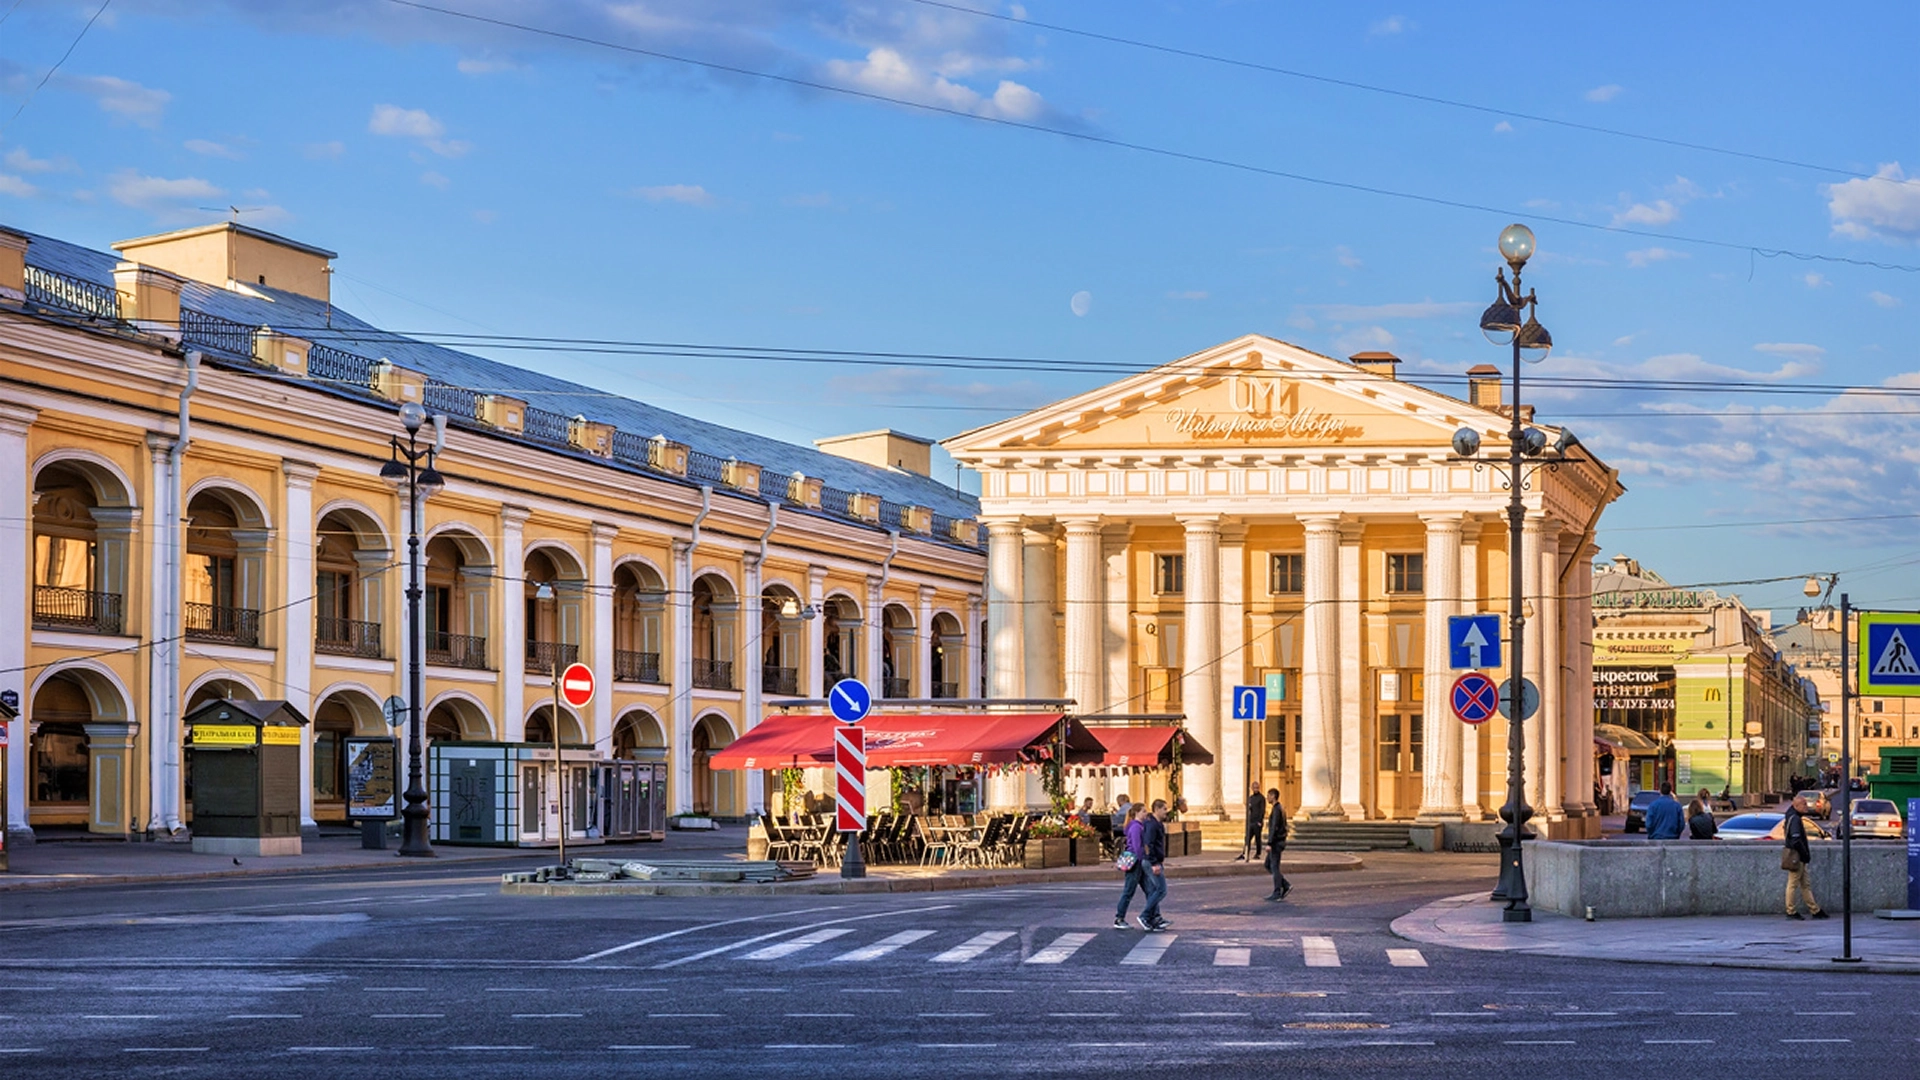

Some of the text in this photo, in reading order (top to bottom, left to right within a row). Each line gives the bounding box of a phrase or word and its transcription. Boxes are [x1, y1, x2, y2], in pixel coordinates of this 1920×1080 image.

[1635, 591, 1697, 607] РЯДЫ
[1596, 685, 1653, 697] ЦЕНТР
[1612, 699, 1647, 709] КЛУБ
